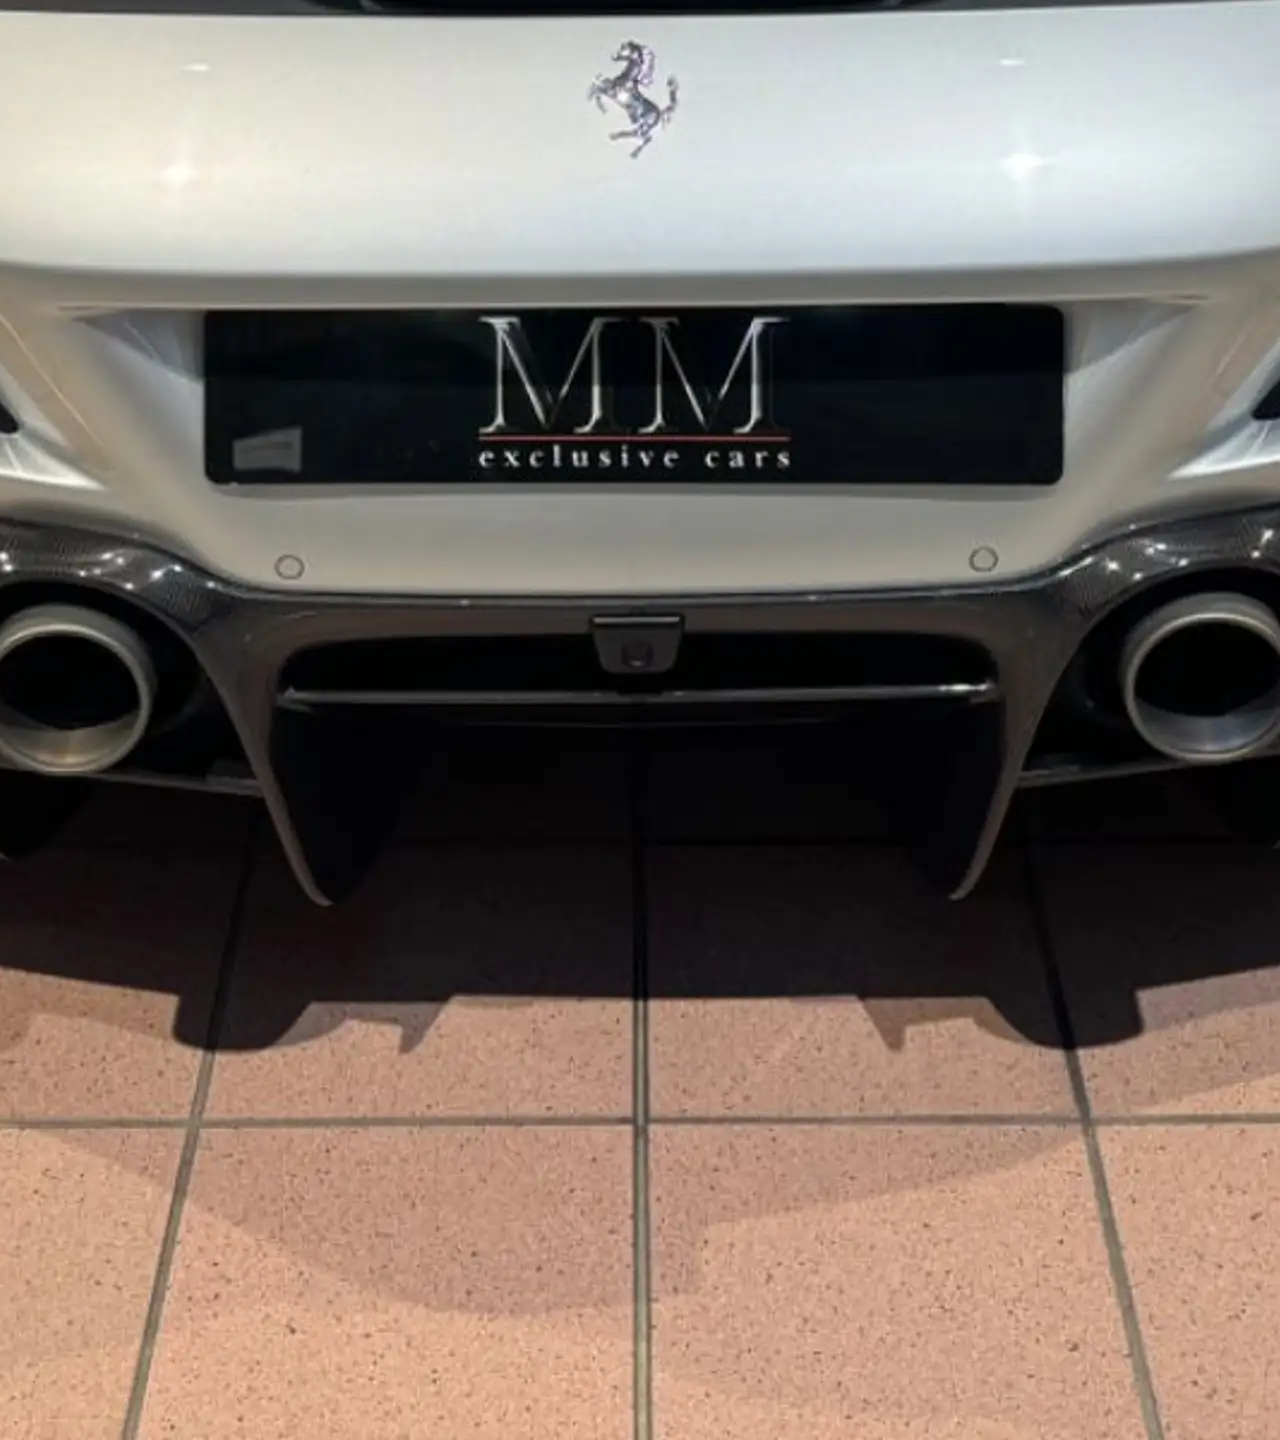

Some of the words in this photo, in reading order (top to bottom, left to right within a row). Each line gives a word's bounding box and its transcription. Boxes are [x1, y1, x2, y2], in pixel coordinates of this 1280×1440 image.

[477, 315, 792, 434] MM
[478, 444, 680, 468] exclusive
[704, 450, 791, 468] cars
